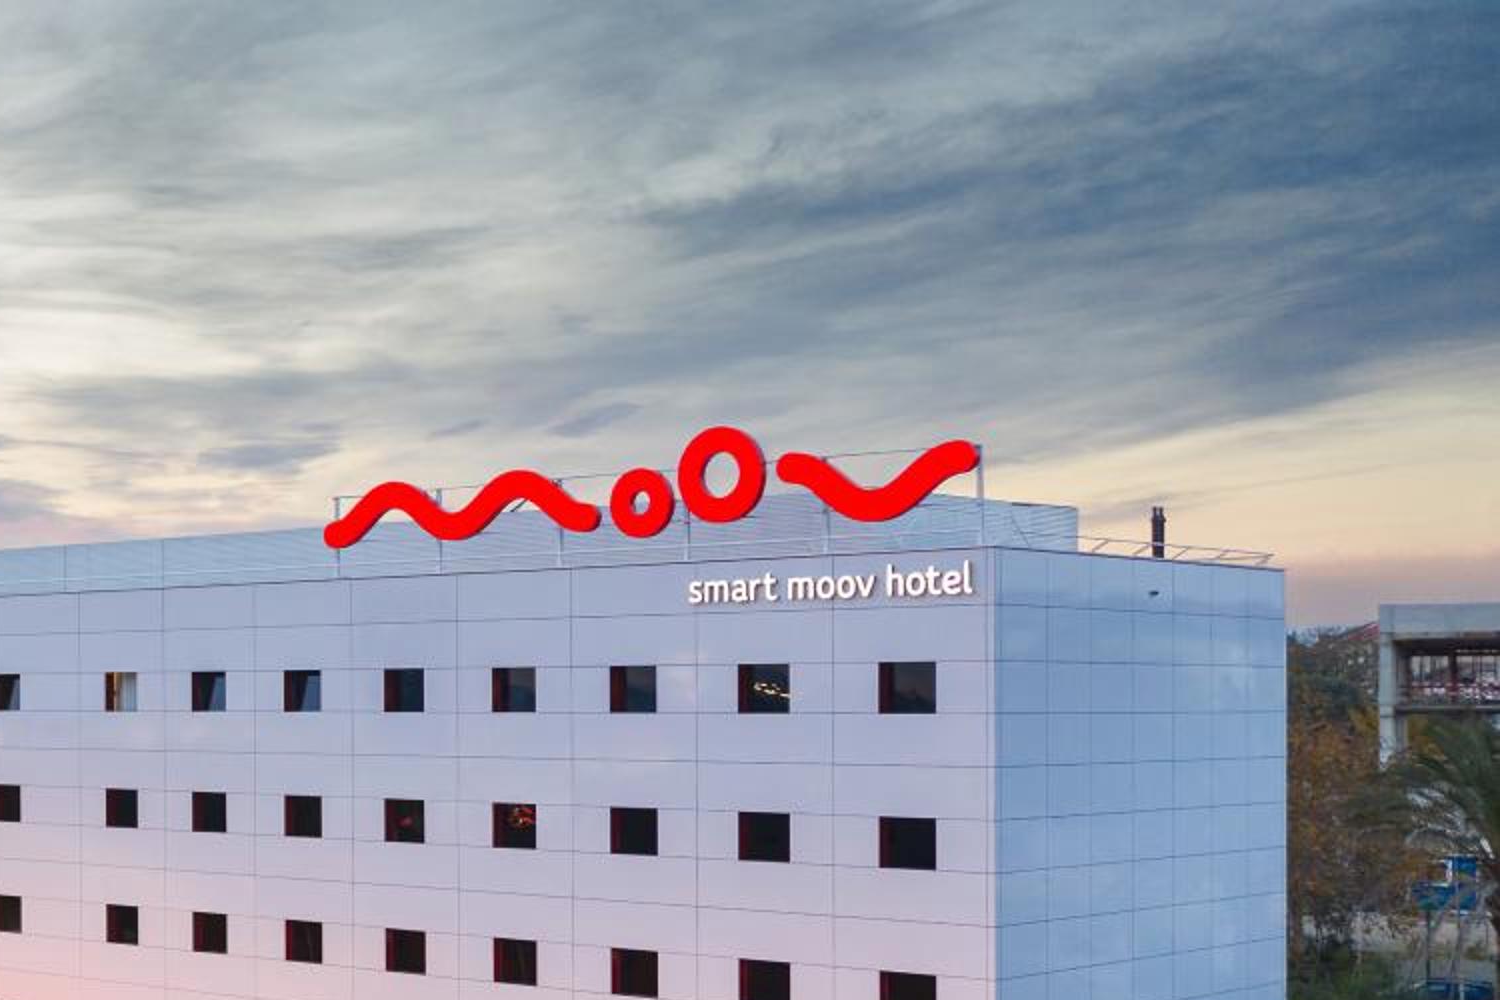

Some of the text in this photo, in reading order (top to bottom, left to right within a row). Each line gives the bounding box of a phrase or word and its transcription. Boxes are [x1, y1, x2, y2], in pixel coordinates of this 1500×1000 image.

[688, 559, 974, 604] smart moov hotel
